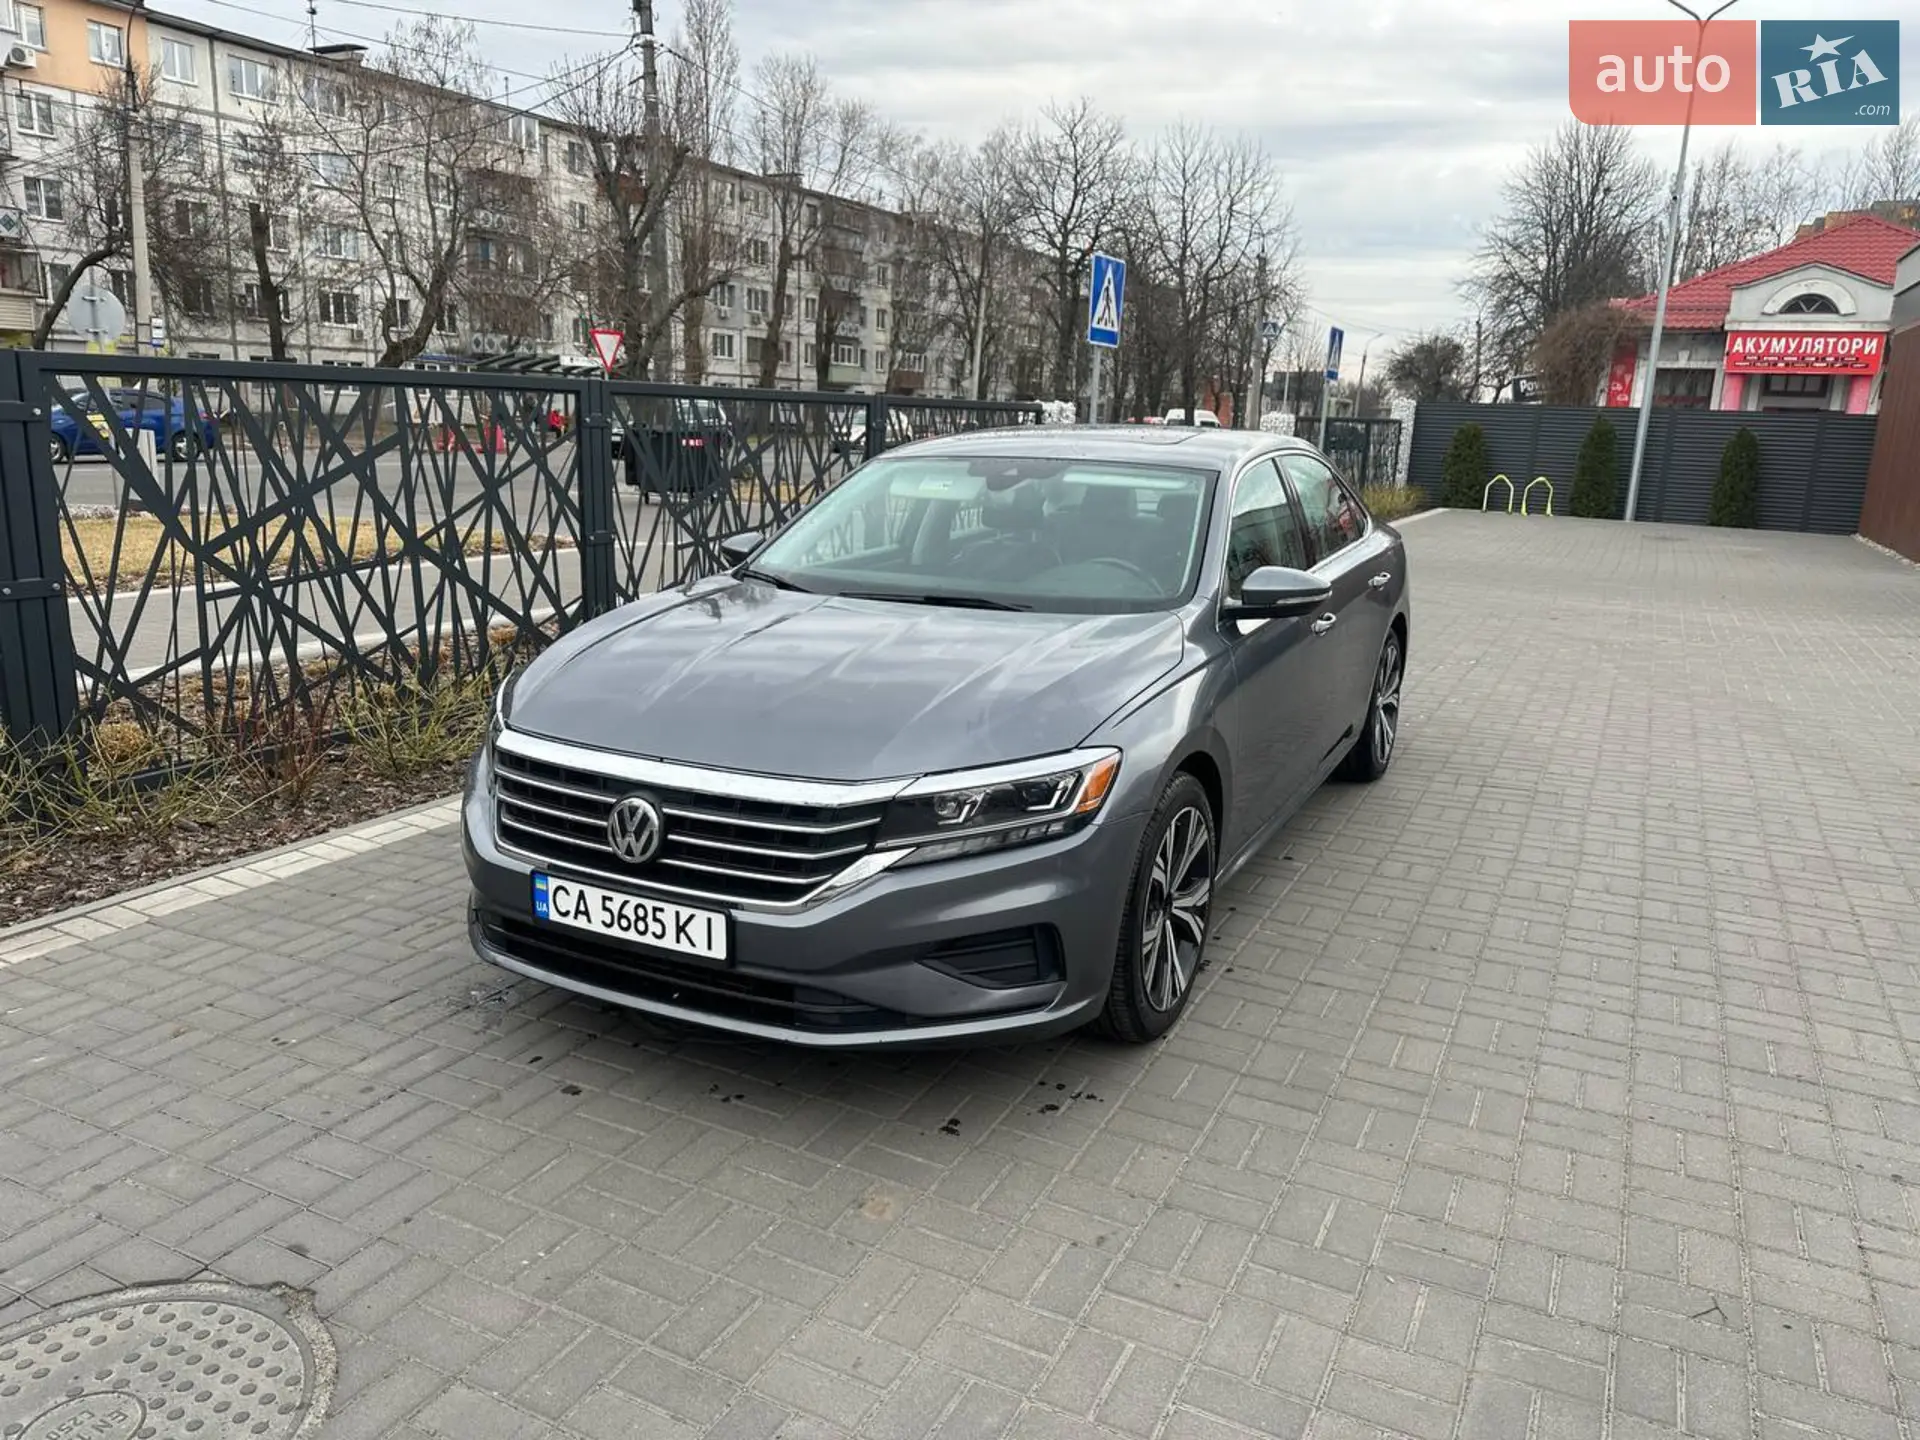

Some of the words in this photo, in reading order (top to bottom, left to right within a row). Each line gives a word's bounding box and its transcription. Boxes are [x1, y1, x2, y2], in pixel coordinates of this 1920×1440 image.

[1732, 337, 1878, 355] АКУМУЛЯТОРИ
[609, 798, 660, 862] VW
[535, 900, 548, 913] UA
[552, 885, 592, 924] CA
[601, 896, 667, 940] 5685
[675, 910, 713, 951] KI
